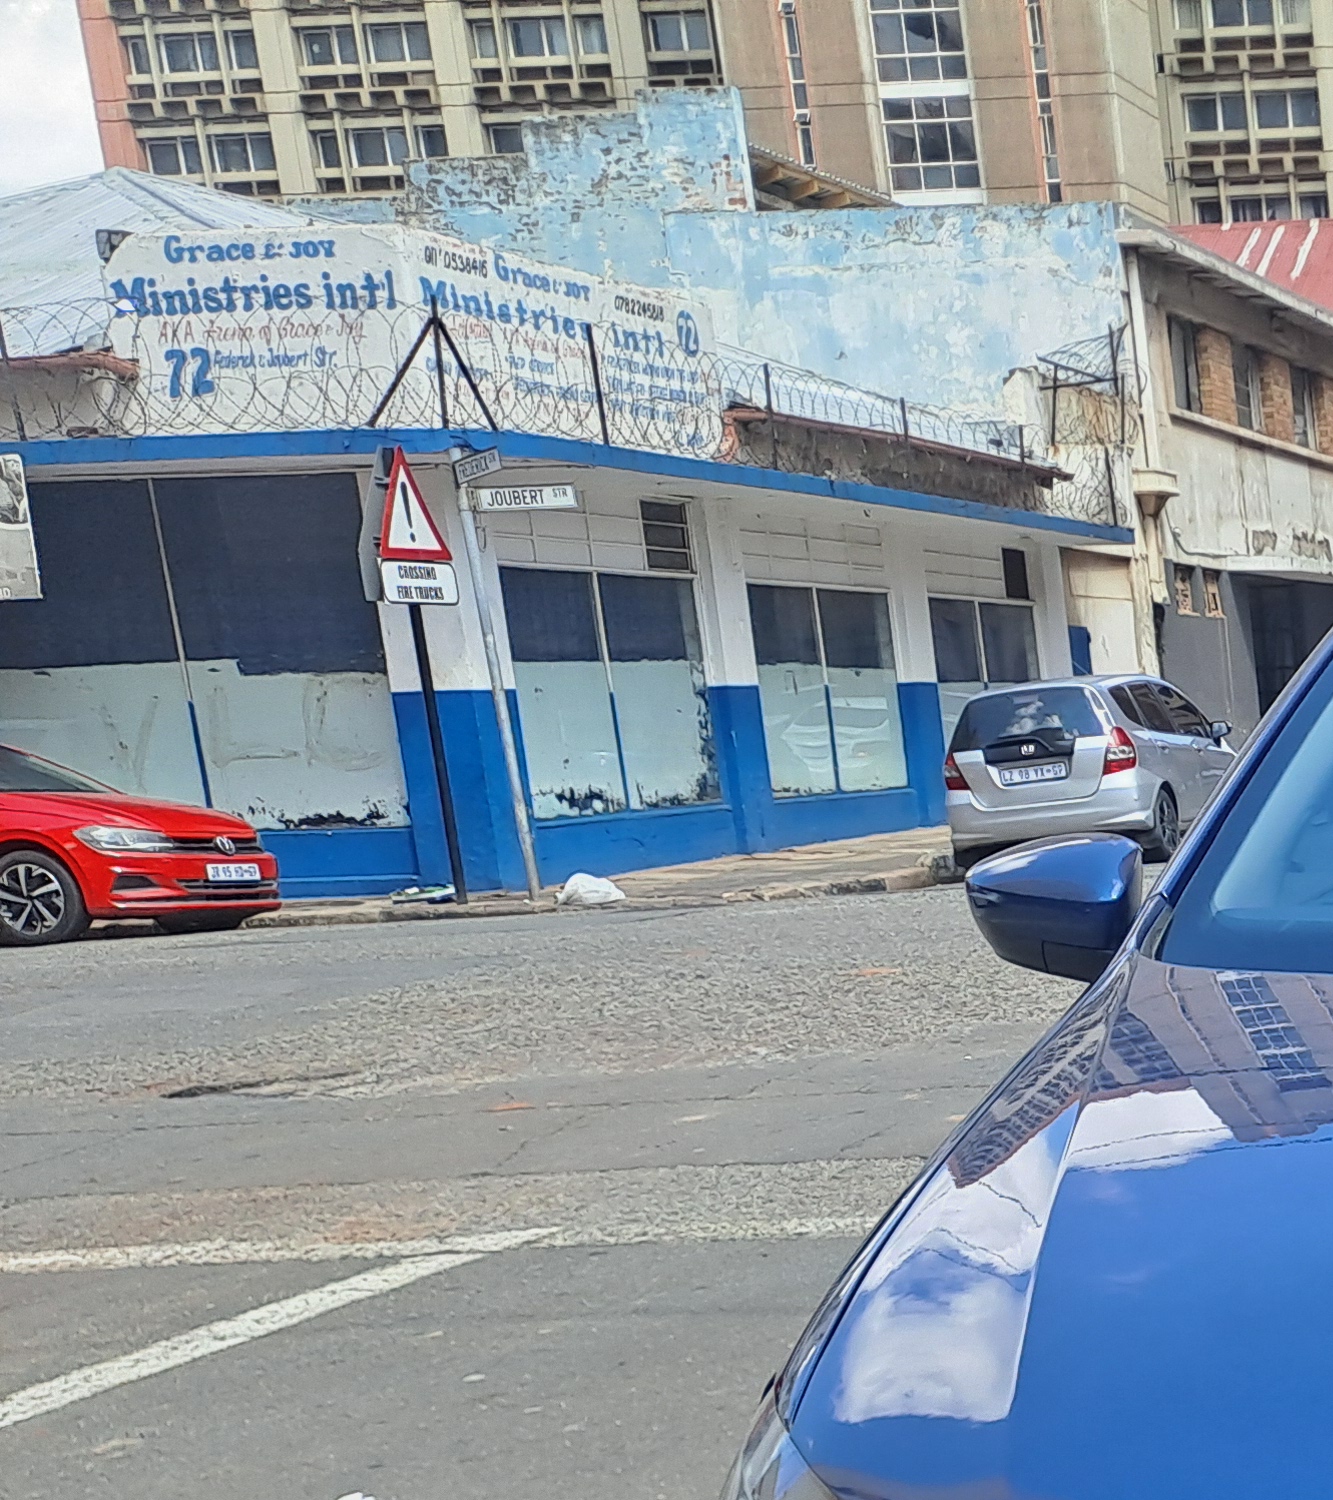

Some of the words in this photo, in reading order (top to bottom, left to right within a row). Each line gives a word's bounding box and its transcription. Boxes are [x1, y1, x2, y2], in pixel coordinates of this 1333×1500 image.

[163, 235, 256, 264] Grace
[493, 253, 551, 293] Grace
[109, 275, 314, 318] Ministries
[419, 276, 592, 341] Ministries
[164, 347, 215, 398] 72
[487, 489, 545, 507] JOUBERT
[552, 487, 568, 498] STR
